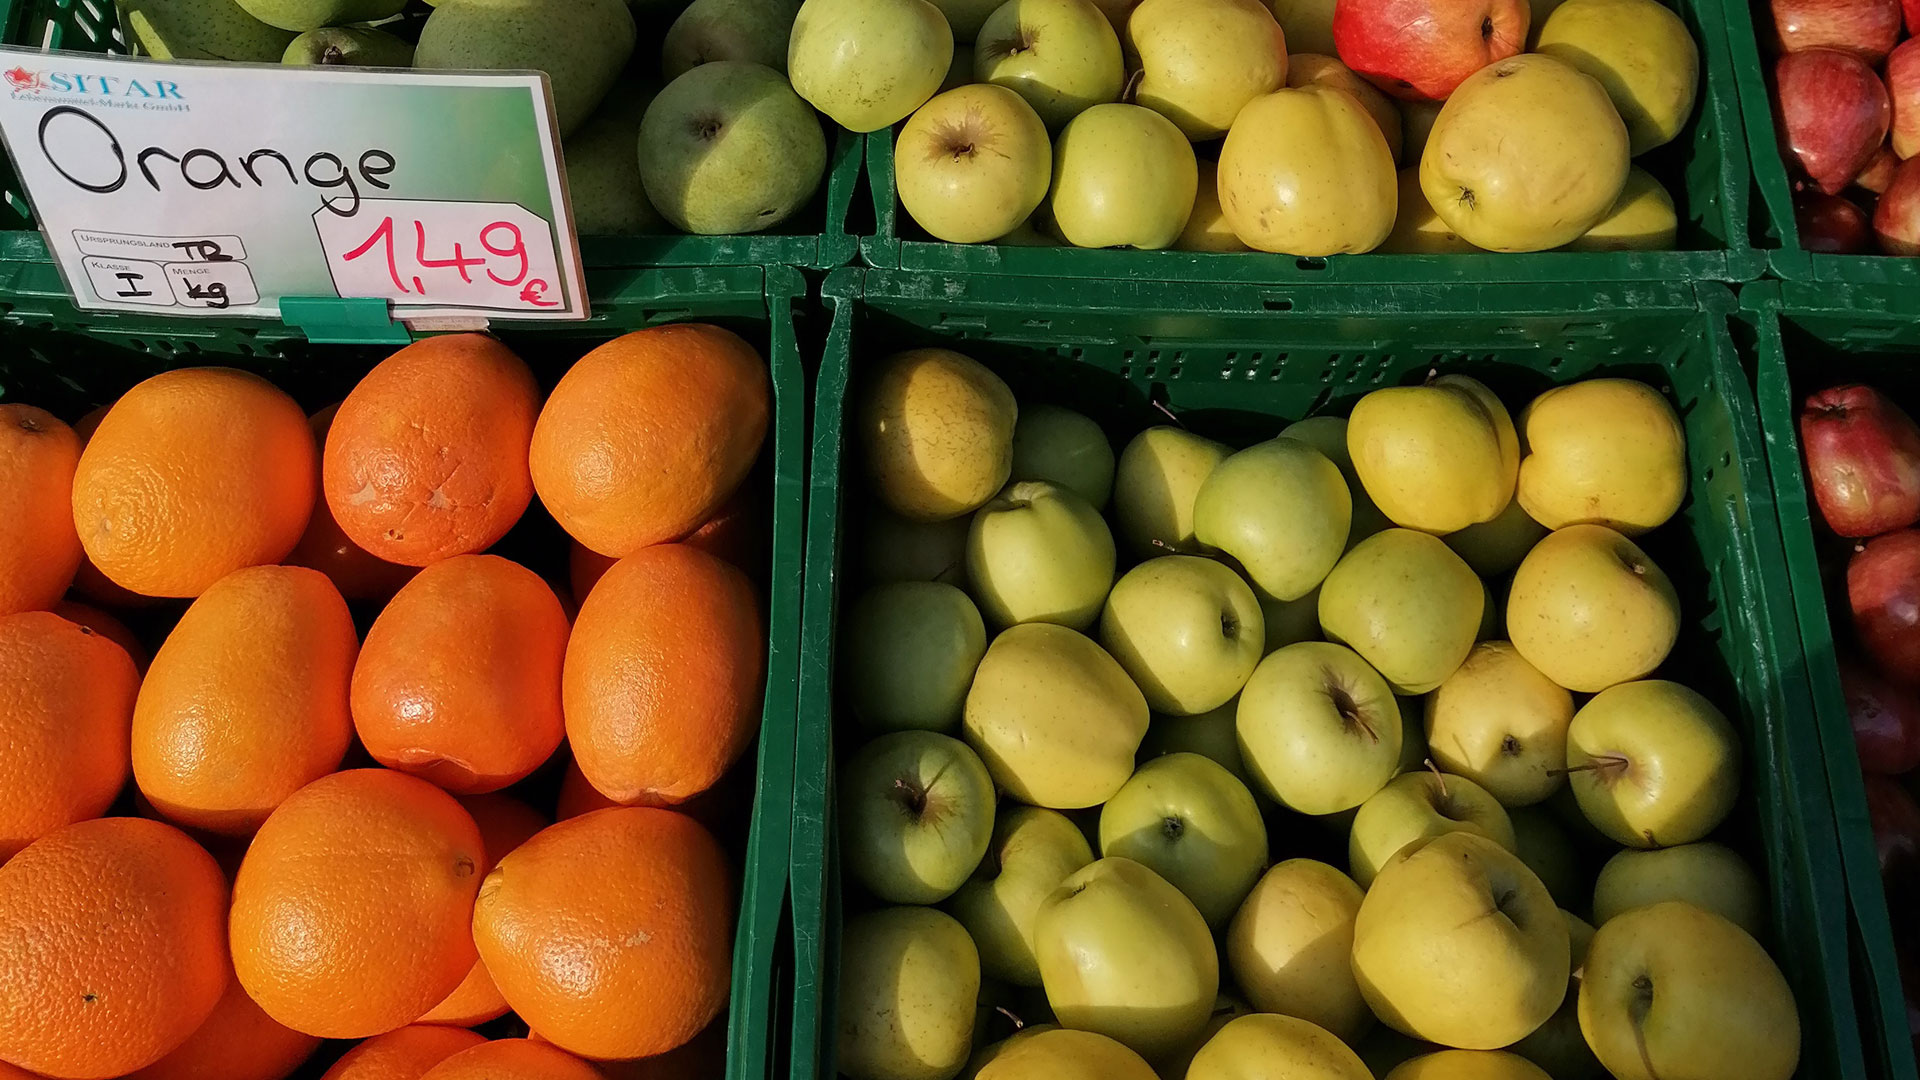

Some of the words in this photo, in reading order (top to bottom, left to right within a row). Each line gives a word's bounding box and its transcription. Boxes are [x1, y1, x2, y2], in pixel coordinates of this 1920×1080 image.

[49, 71, 186, 100] SITAR
[38, 104, 396, 218] Orange
[343, 216, 529, 296] 1,49
[519, 278, 559, 307] €
[182, 277, 230, 309] kg
